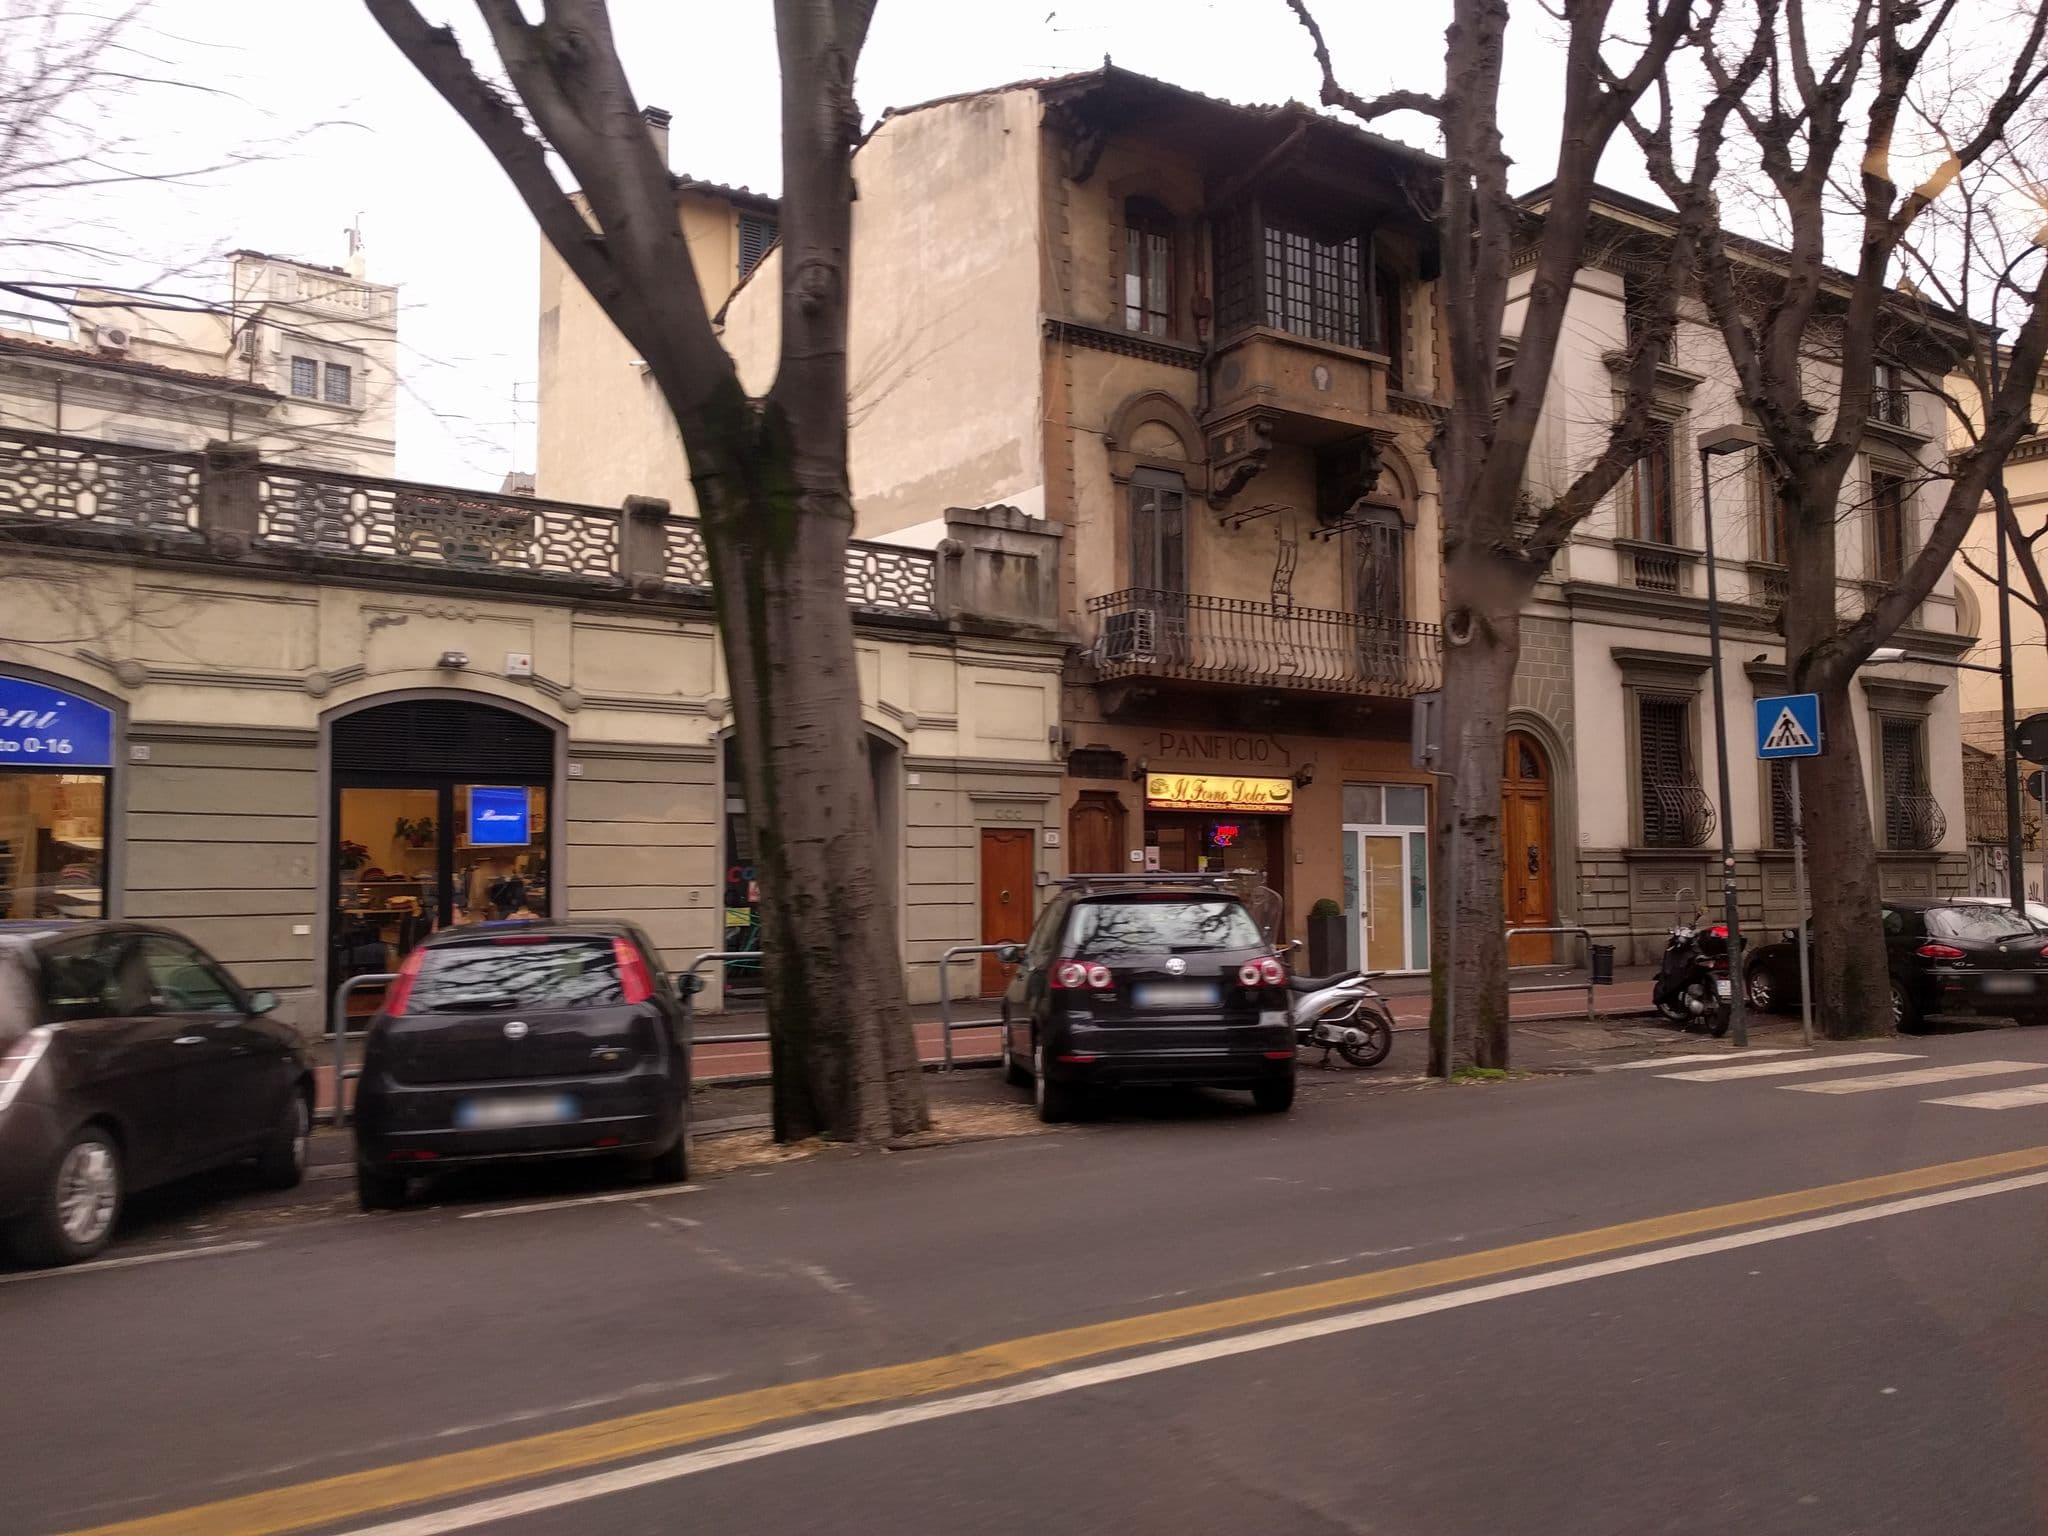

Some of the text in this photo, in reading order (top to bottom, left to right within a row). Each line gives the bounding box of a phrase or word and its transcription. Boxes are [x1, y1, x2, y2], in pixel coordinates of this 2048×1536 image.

[23, 737, 74, 754] 0-16
[1159, 732, 1270, 762] PANIFICIO
[1231, 778, 1267, 803] Dolce
